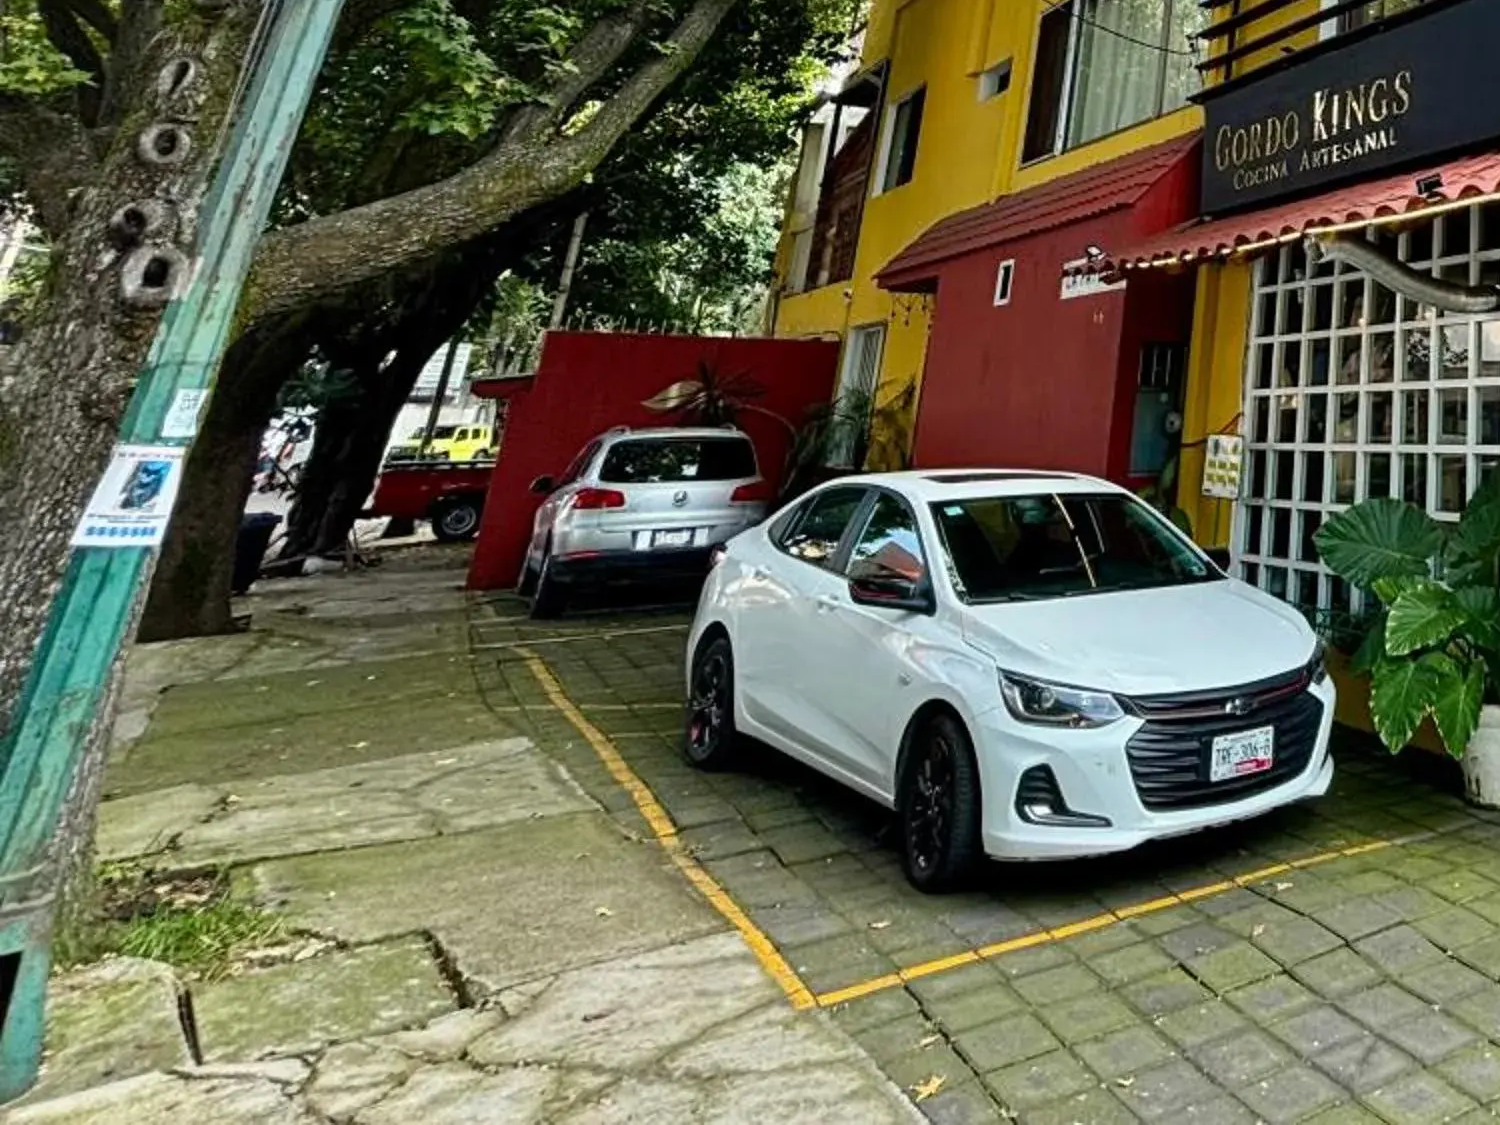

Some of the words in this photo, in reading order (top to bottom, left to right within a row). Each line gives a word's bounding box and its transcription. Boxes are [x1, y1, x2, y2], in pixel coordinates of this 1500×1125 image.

[1215, 110, 1300, 172] GORDO
[1313, 70, 1412, 143] KINGS
[1232, 160, 1289, 192] COCINA
[1298, 126, 1399, 173] ARTESANAL
